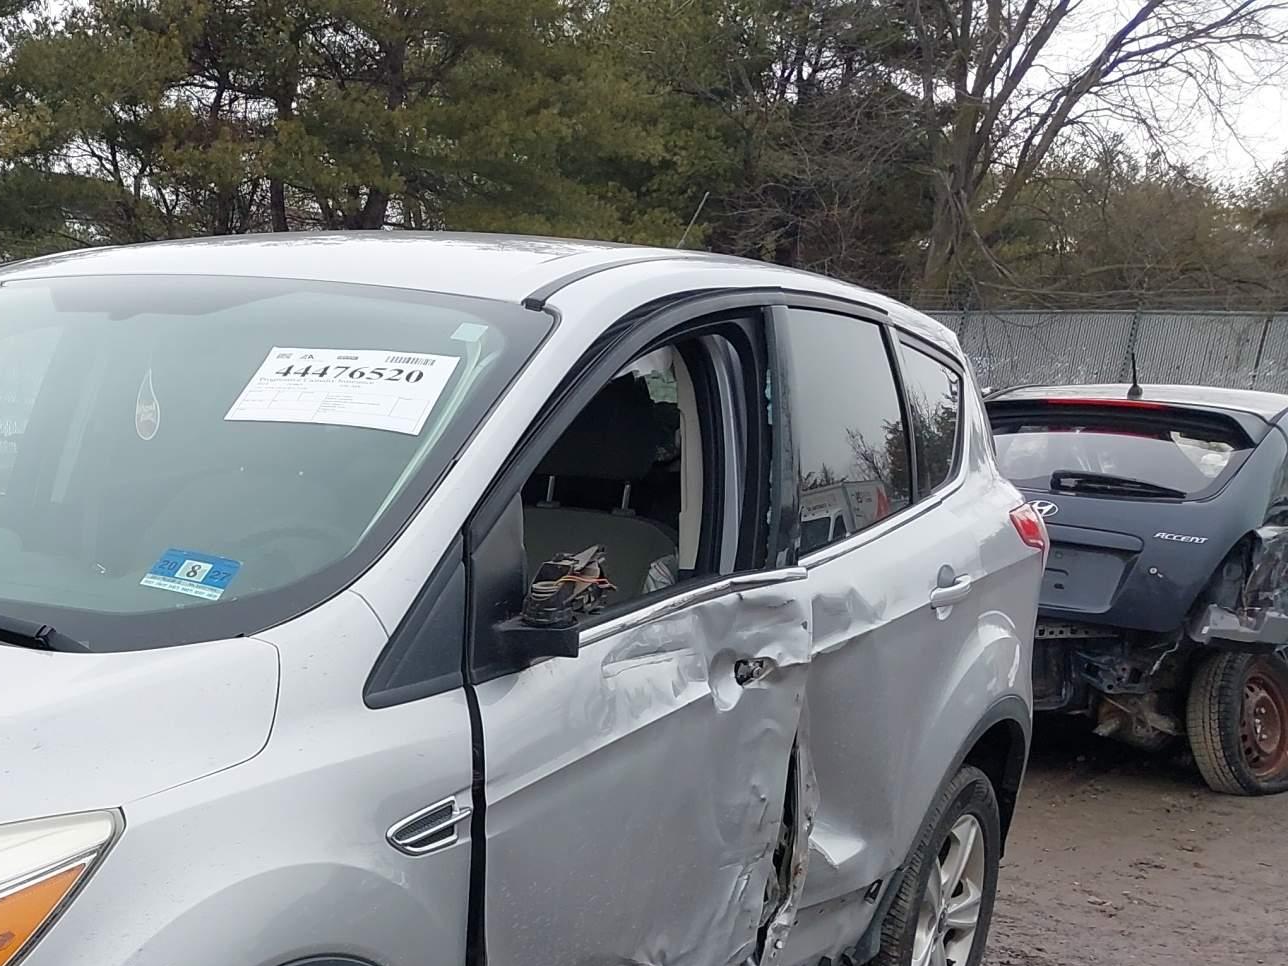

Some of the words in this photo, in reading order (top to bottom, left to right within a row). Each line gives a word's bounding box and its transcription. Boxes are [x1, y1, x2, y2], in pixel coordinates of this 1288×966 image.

[274, 364, 424, 384] 44476520
[1152, 532, 1209, 544] ACCENT
[158, 560, 178, 572] 20
[185, 564, 202, 578] 8
